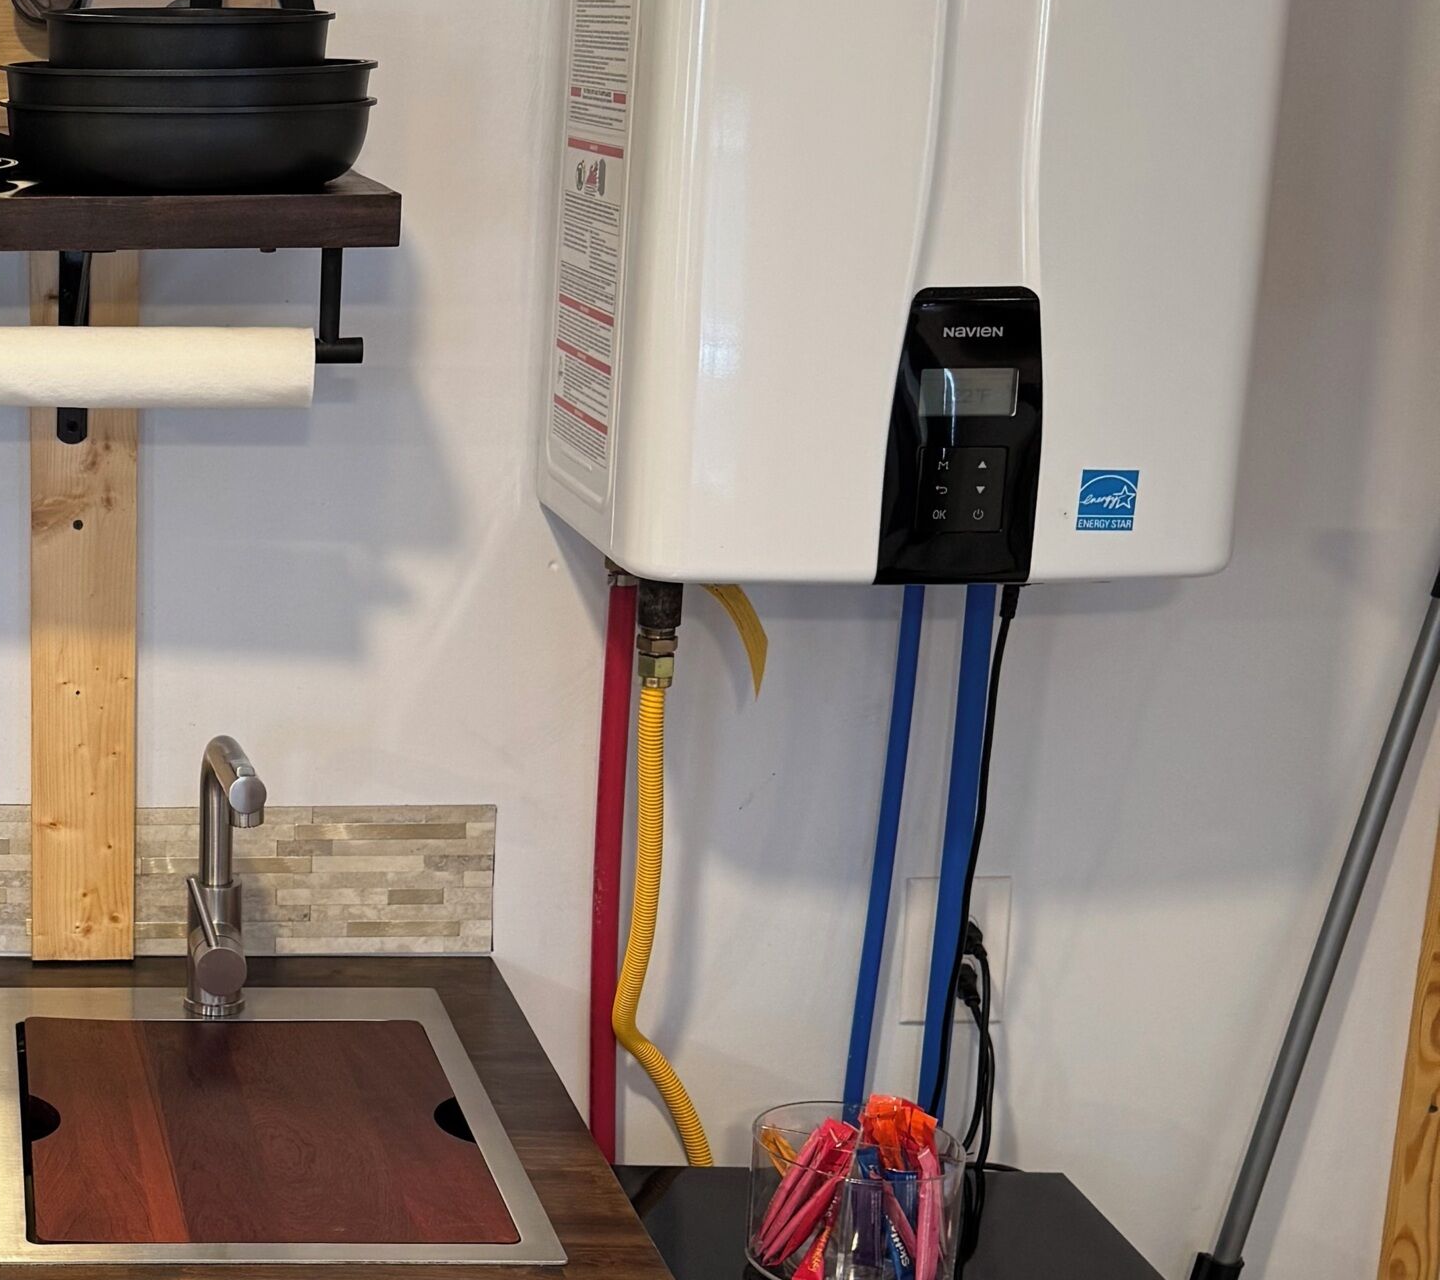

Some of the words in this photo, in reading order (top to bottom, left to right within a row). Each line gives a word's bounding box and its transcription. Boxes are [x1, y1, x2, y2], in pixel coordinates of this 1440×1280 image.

[937, 460, 950, 471] M
[1079, 493, 1120, 510] energy
[932, 508, 947, 520] OK
[1077, 518, 1110, 529] ENERGY
[1110, 518, 1132, 529] STAR
